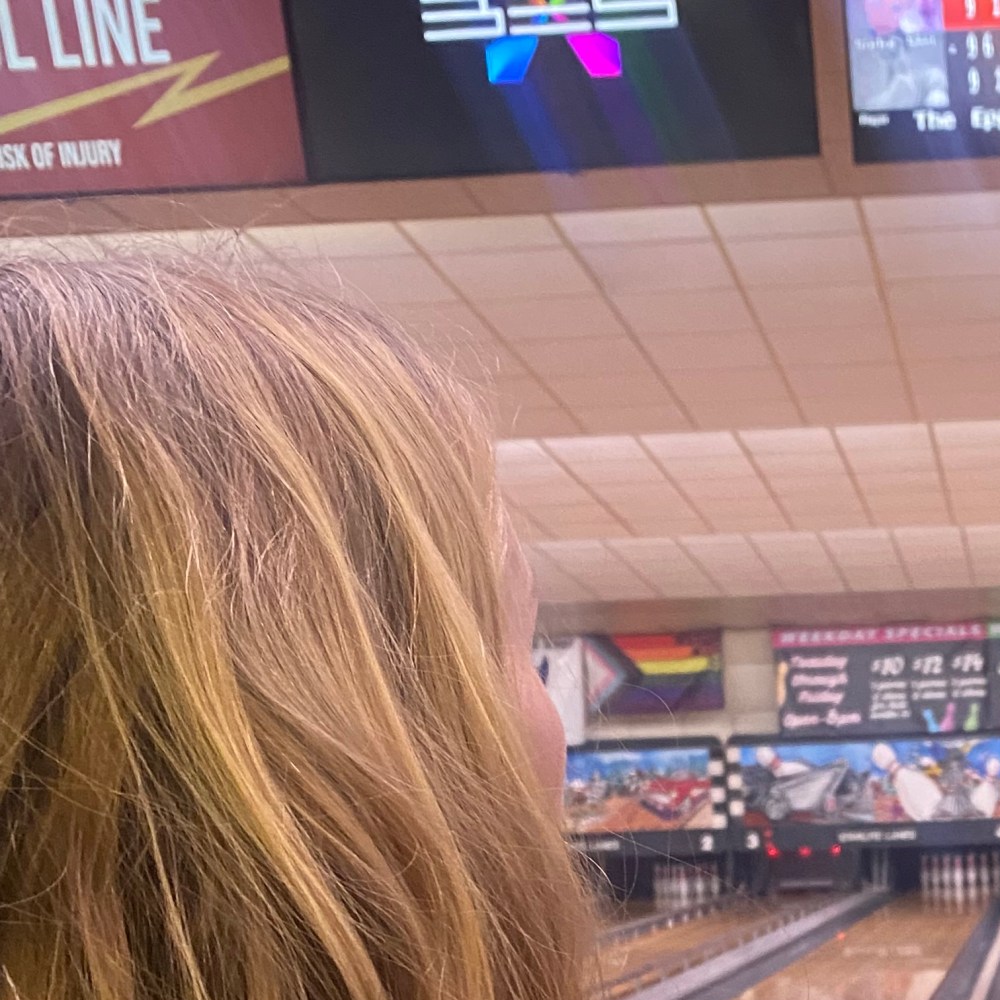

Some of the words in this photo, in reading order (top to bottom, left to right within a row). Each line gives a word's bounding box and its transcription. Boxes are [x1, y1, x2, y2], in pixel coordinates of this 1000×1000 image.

[42, 0, 171, 68] LINE
[912, 109, 957, 131] The
[0, 143, 30, 171] ISK
[31, 141, 54, 170] OF
[58, 138, 122, 168] INJURY
[885, 623, 982, 640] SPECIALS
